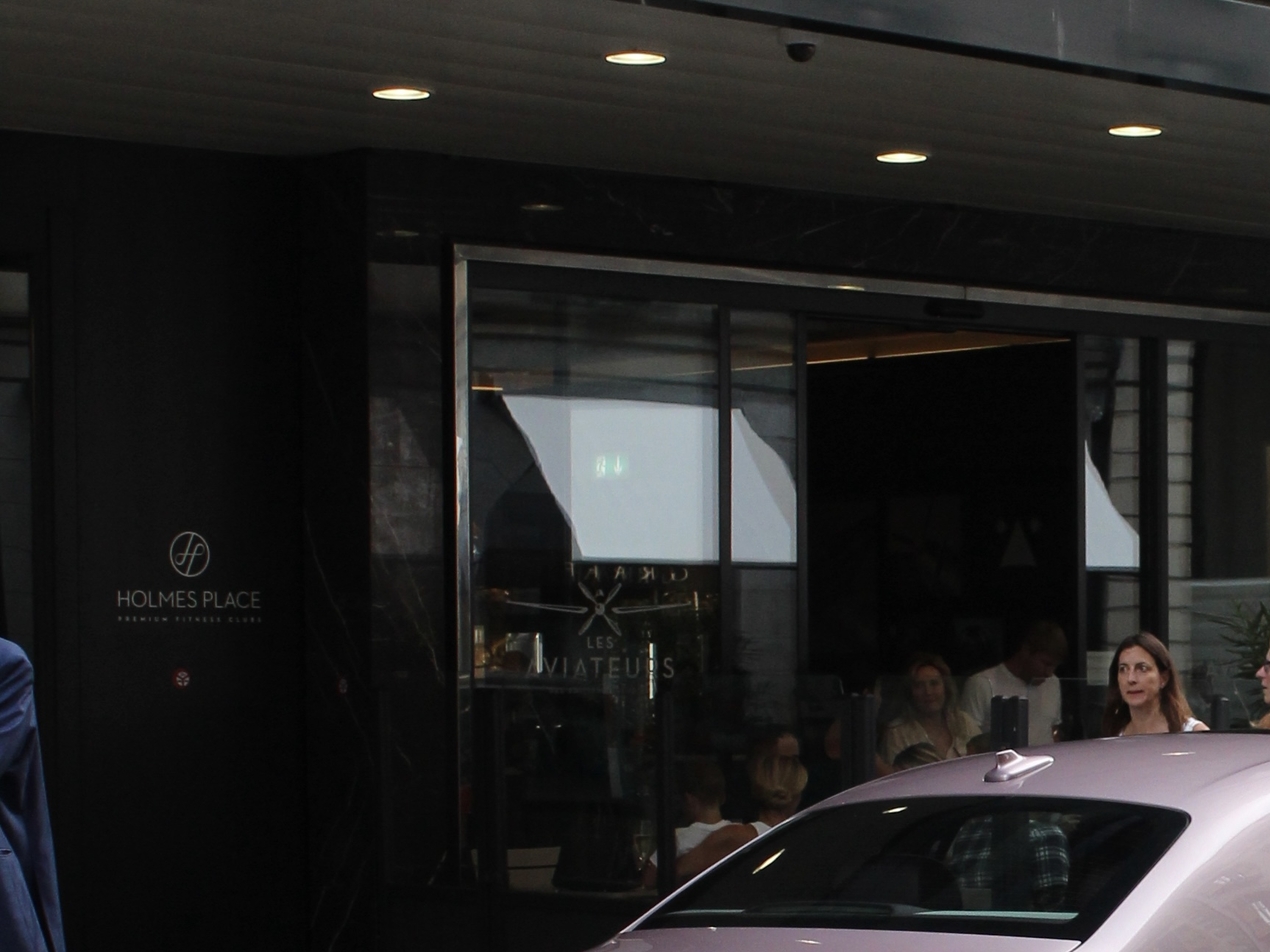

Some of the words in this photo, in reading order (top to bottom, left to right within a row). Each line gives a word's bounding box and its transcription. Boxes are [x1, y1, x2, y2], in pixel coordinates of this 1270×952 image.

[117, 590, 198, 608] HOLMES
[203, 591, 262, 609] PLACE
[117, 615, 168, 623] PREMIUM
[587, 636, 614, 649] LES
